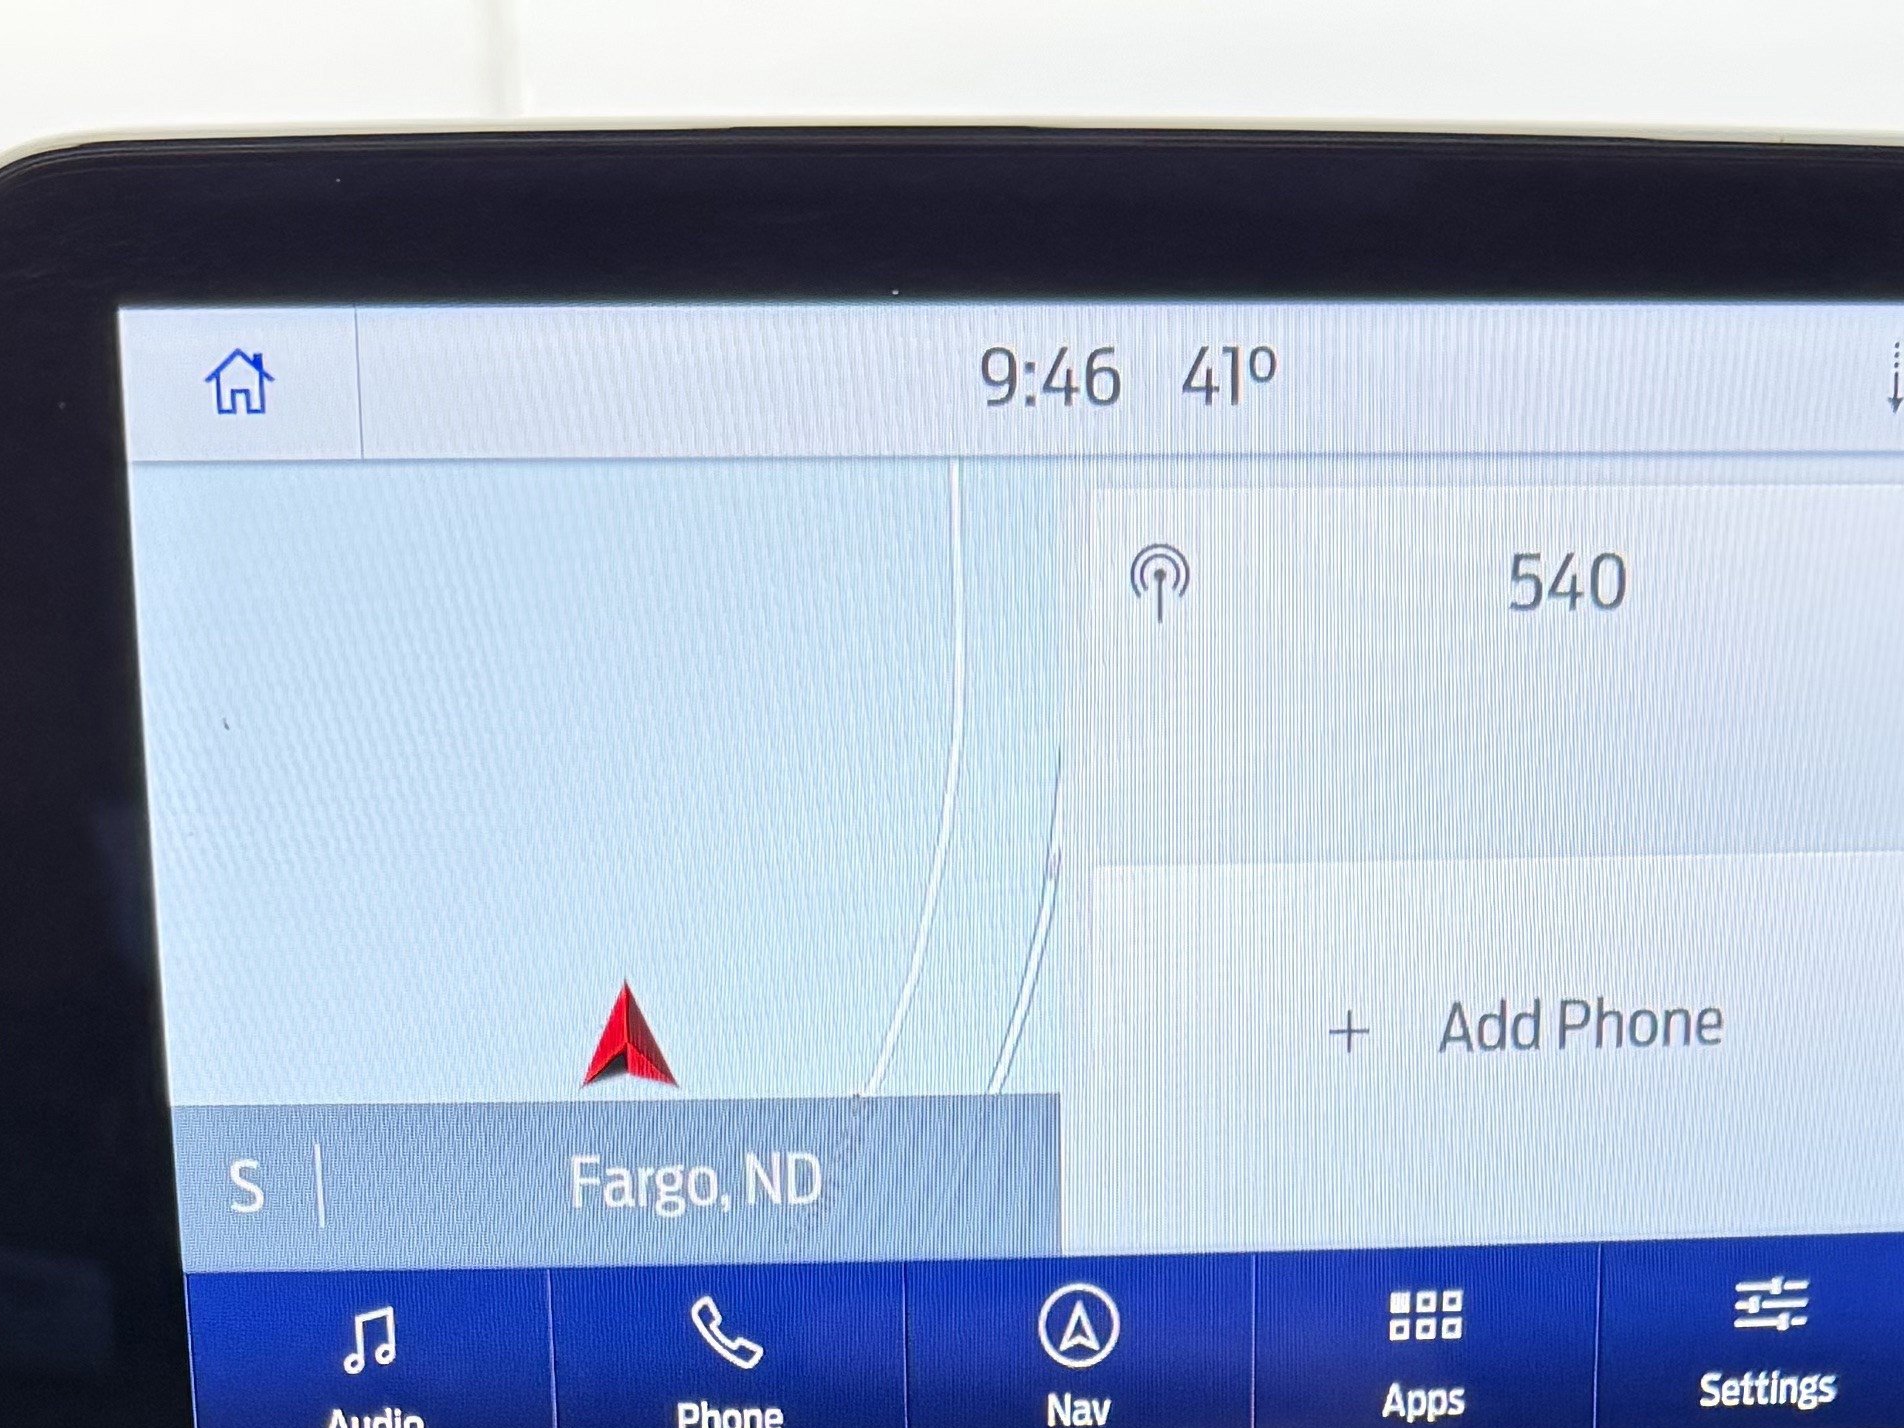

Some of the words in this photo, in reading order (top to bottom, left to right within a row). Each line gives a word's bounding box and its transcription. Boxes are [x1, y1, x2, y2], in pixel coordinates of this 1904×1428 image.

[980, 346, 1122, 408] 9:46
[1508, 552, 1628, 612] 540
[1438, 997, 1543, 1055] Add
[1558, 994, 1726, 1051] Phone
[229, 1158, 265, 1213] S
[570, 1153, 732, 1219] Fargo,
[744, 1150, 824, 1208] ND
[1046, 1392, 1112, 1428] Nav
[1381, 1382, 1466, 1425] Apps
[1698, 1367, 1838, 1412] Settings
